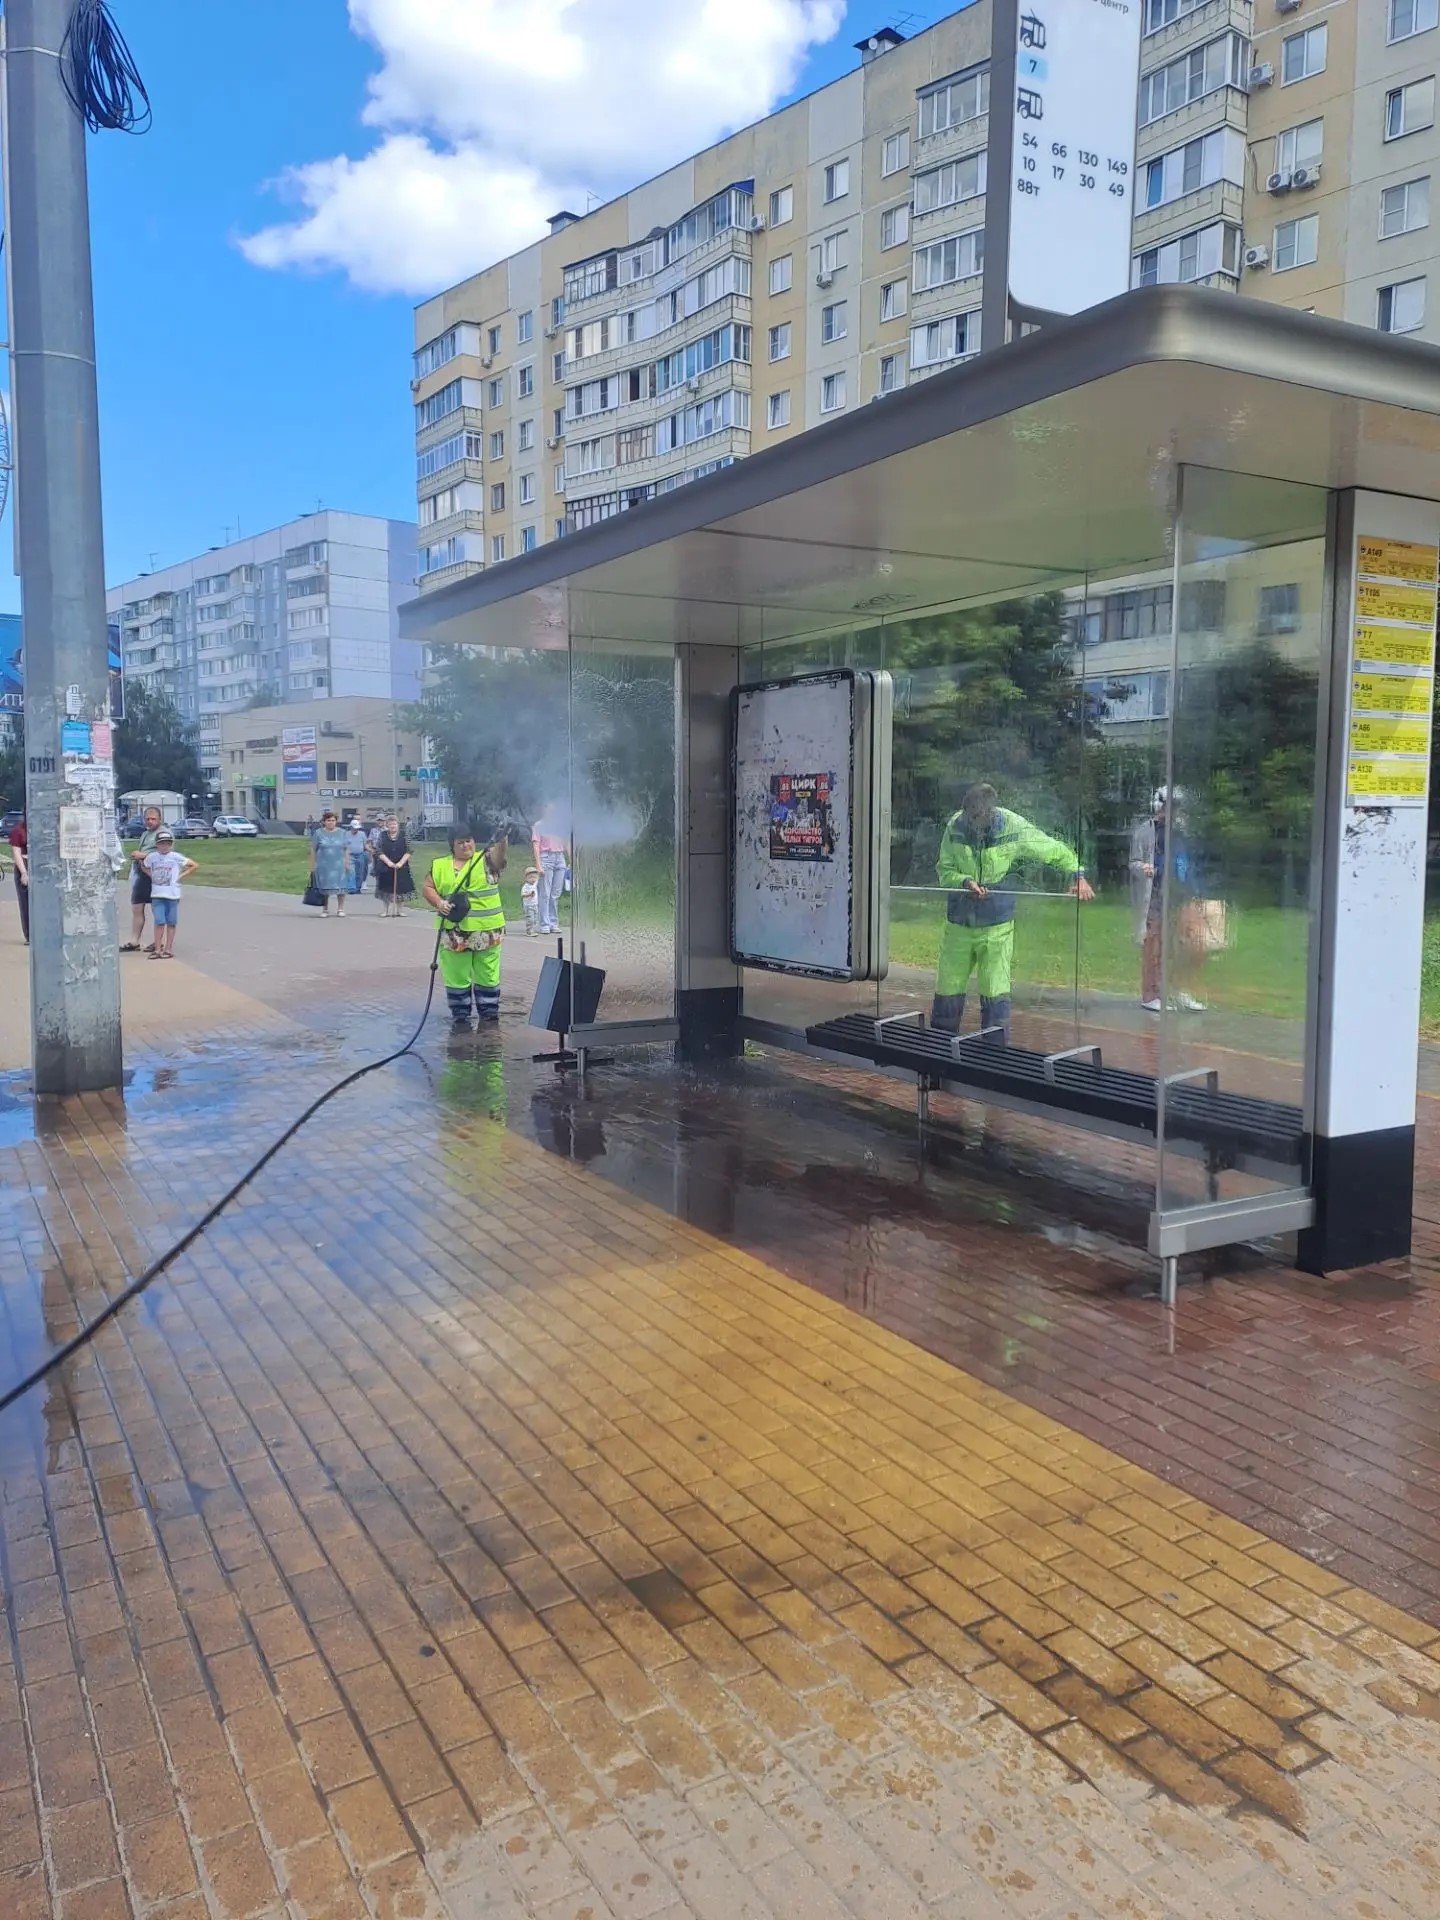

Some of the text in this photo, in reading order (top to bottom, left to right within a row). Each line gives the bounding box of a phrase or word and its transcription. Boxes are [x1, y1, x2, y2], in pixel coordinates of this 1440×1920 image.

[1029, 59, 1037, 73] 7
[1022, 132, 1128, 175] 54 66 130 149
[1023, 156, 1125, 197] 10 17 30 49
[791, 779, 816, 791] ЦИРК
